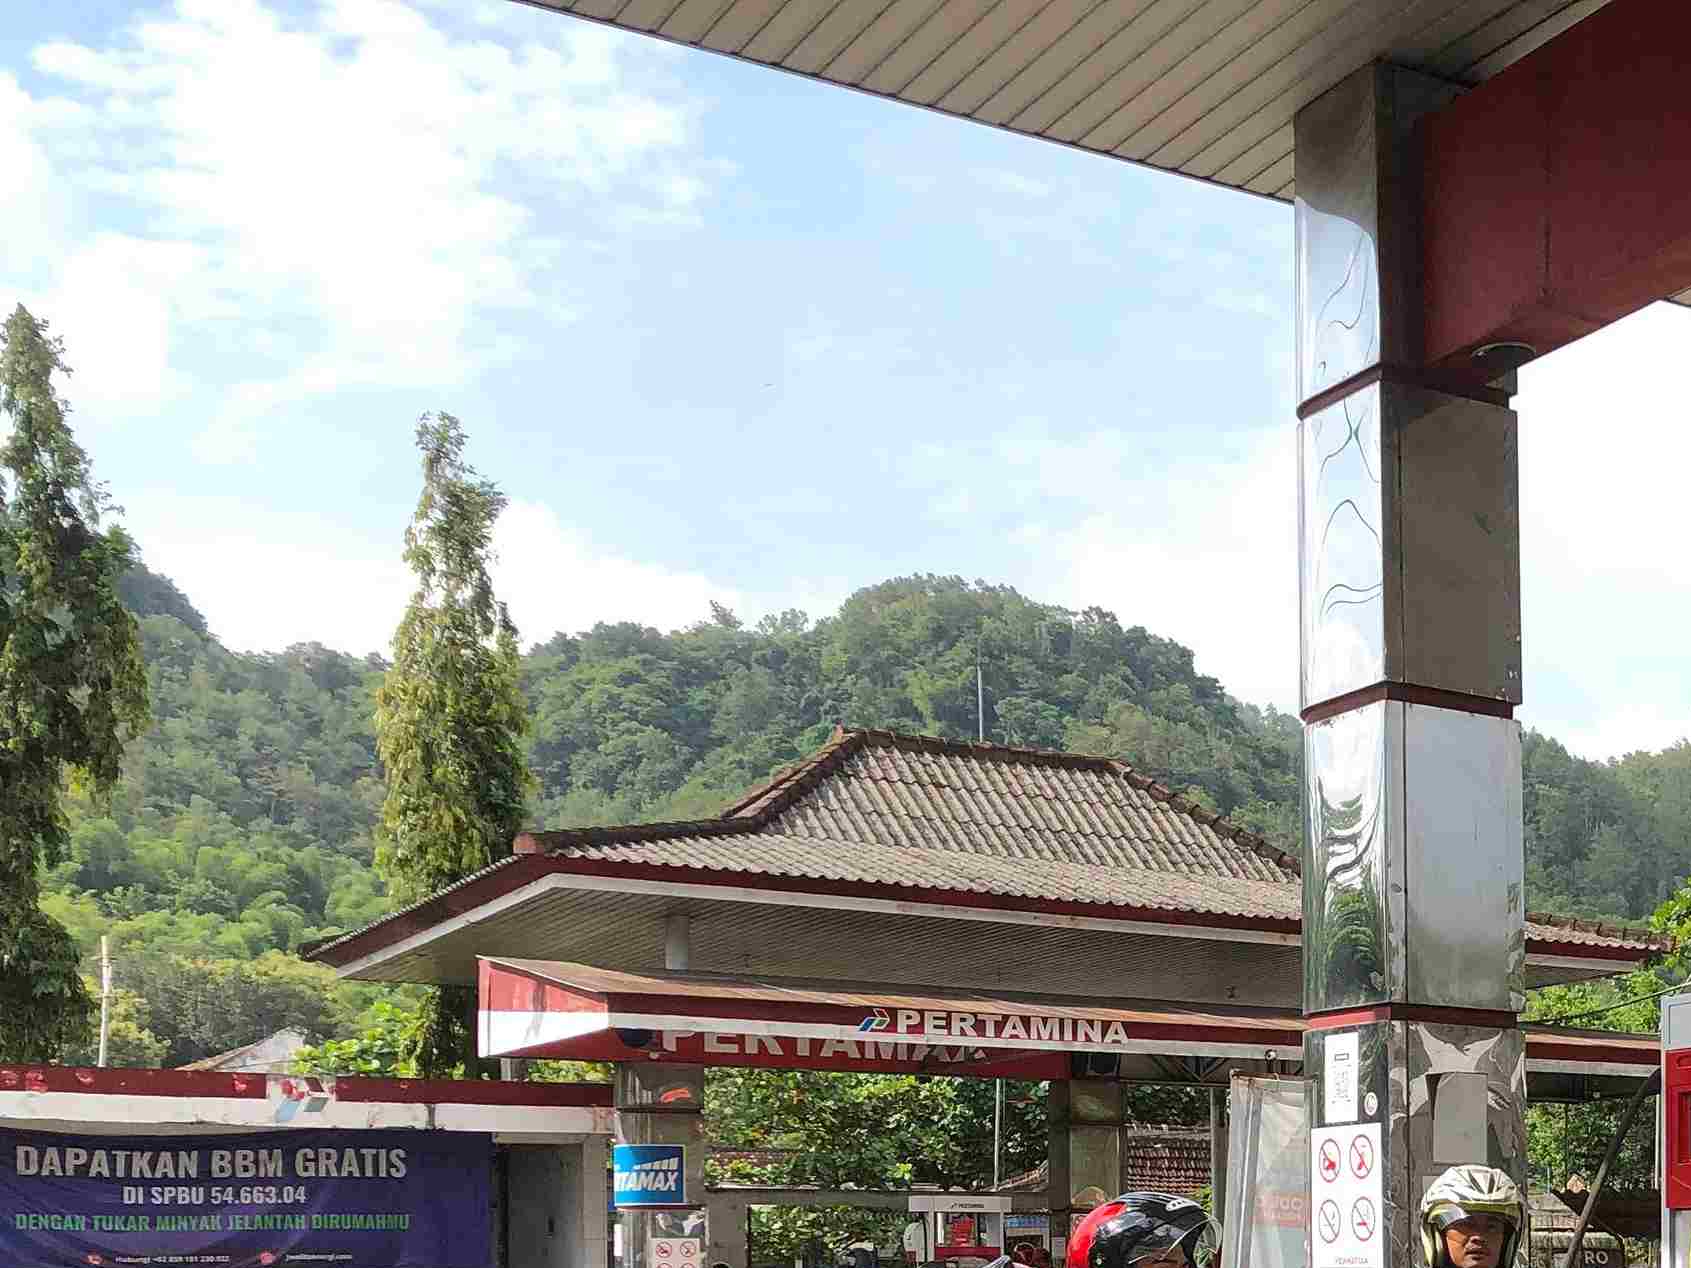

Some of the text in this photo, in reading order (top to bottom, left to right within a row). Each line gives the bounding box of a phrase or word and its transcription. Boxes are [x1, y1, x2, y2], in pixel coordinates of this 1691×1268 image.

[897, 1008, 1128, 1045] PERTAMINA
[15, 1145, 407, 1178] DAPATKAN BBM GRATIS
[614, 1170, 679, 1191] TAMAX
[122, 1185, 306, 1205] DI SPBU 54.663.04
[15, 1213, 410, 1232] DENGAN TUKAR MINYAK JELANTAH DIRUMAHMU
